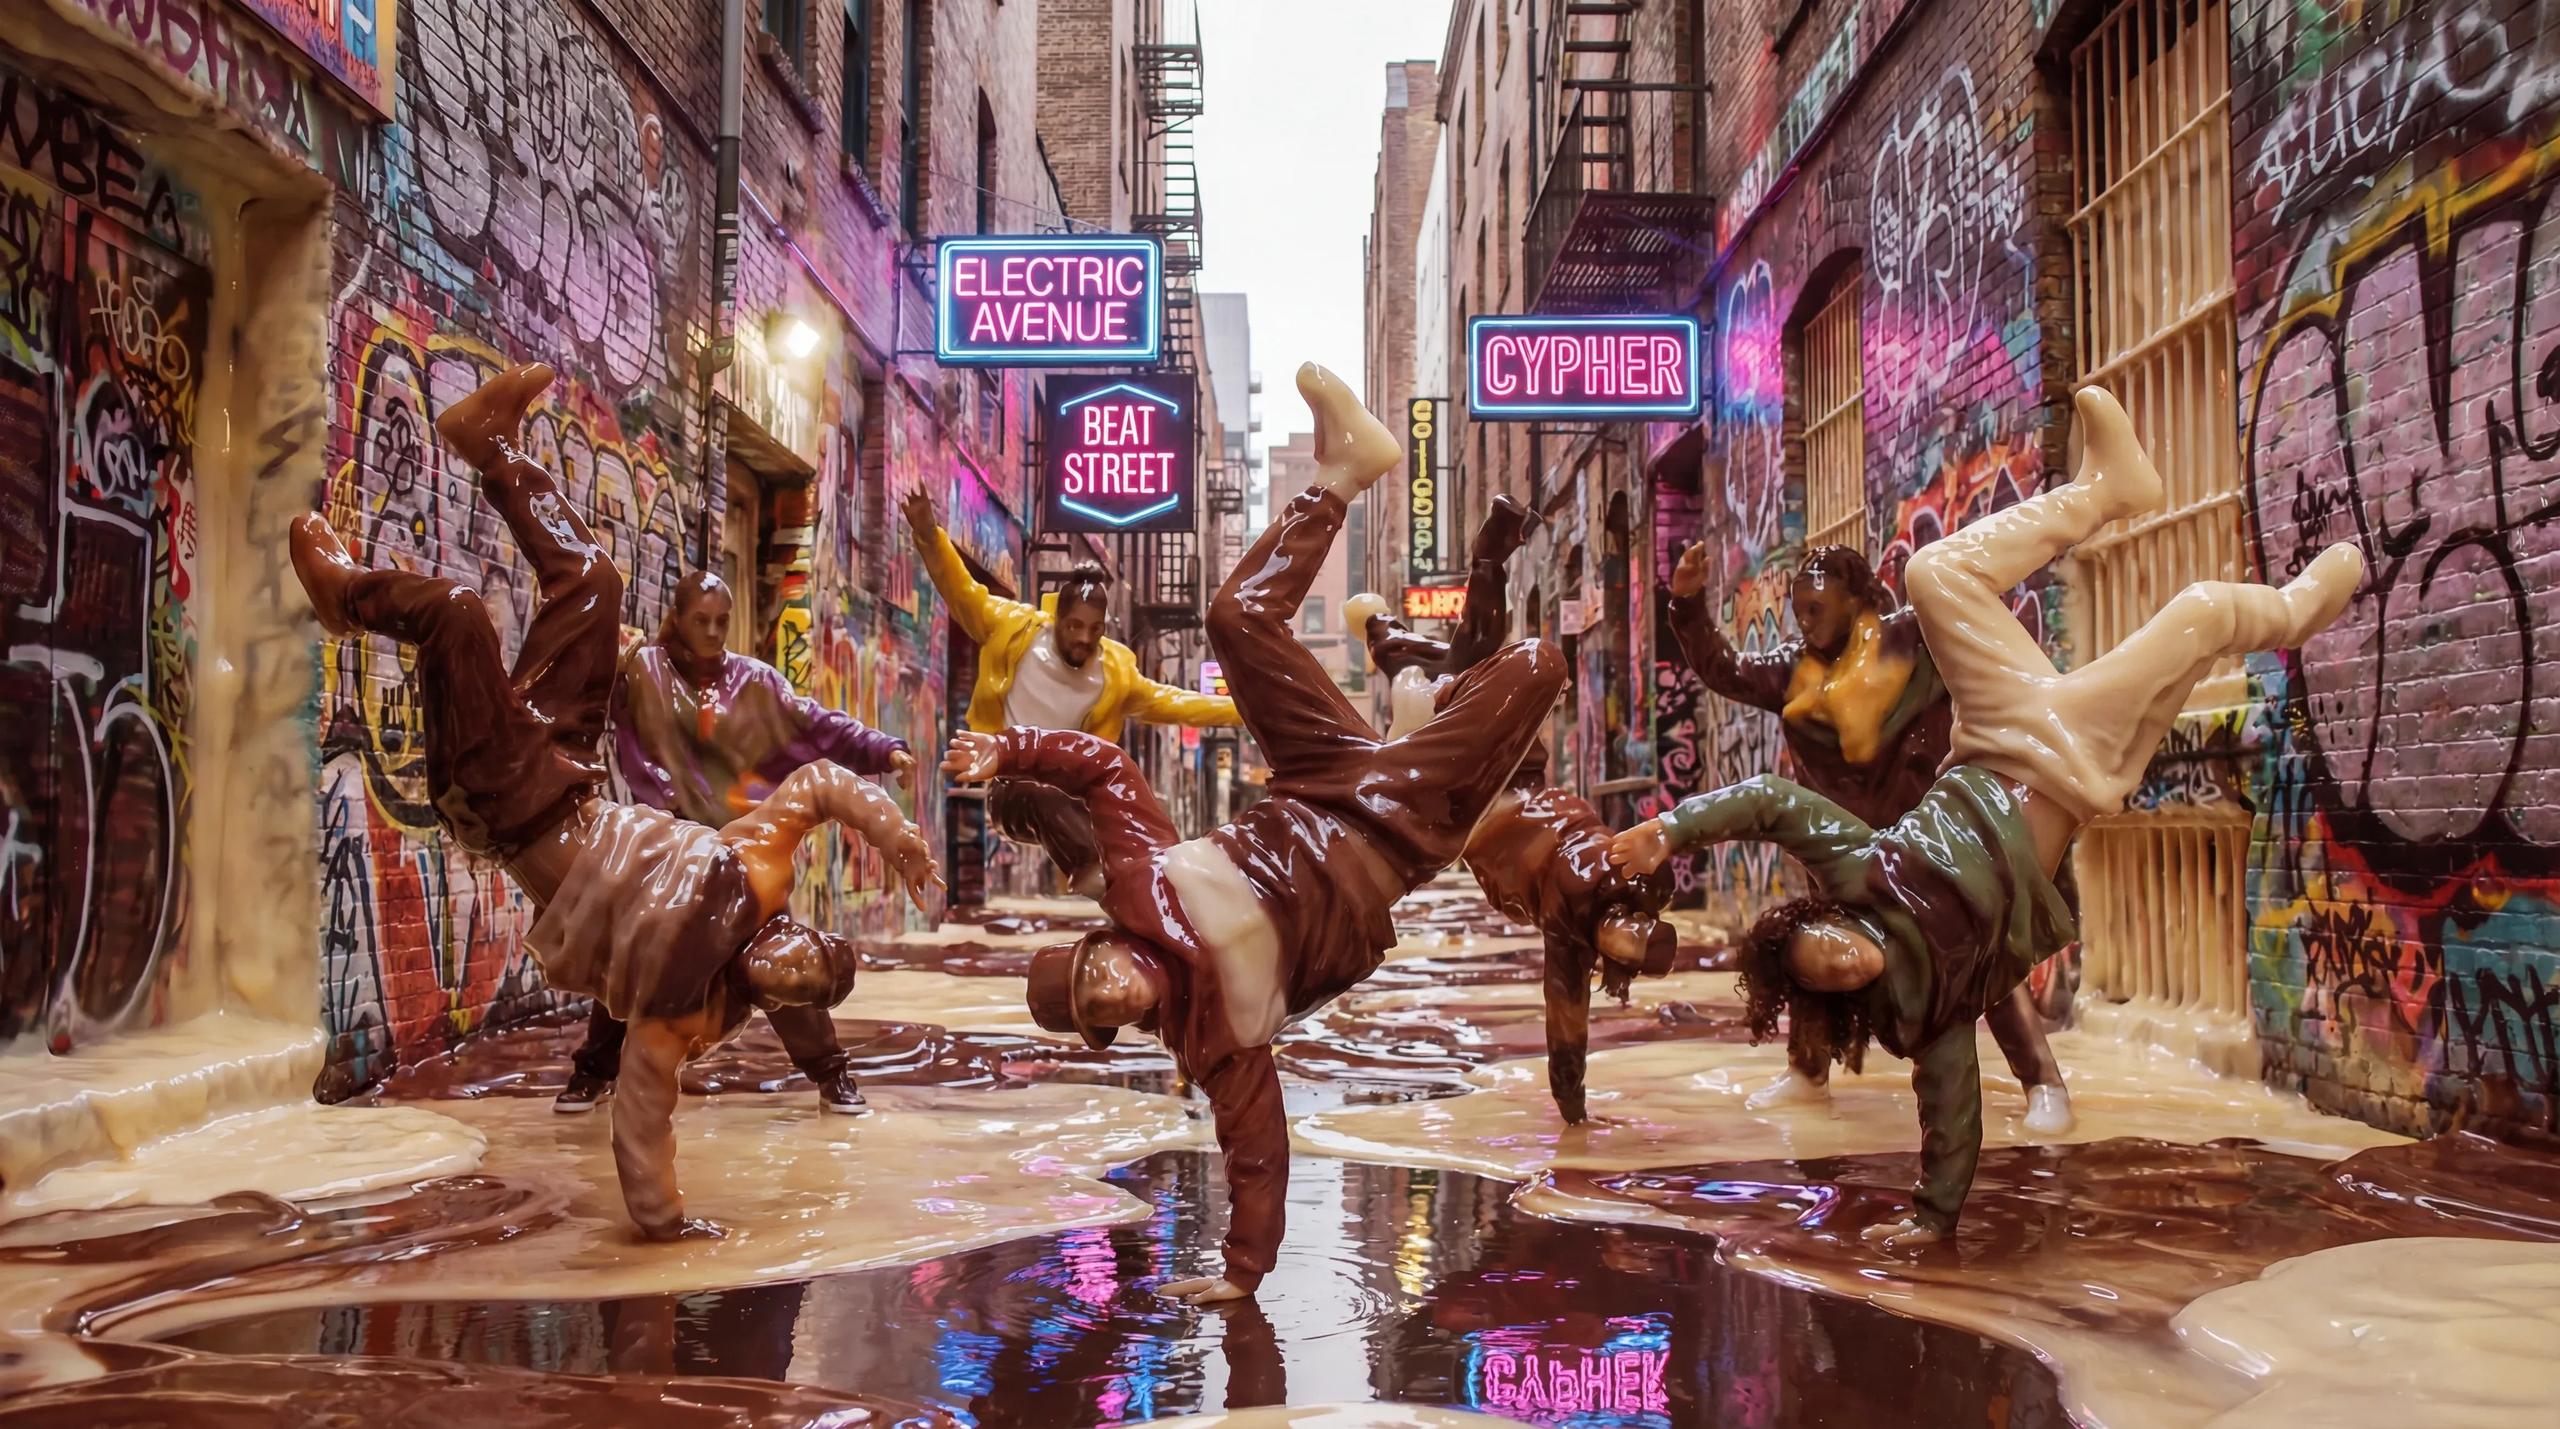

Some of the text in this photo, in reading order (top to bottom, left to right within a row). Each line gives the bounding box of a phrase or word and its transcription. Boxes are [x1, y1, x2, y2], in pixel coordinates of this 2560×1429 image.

[955, 256, 1144, 297] ELECTRIC
[969, 301, 1129, 343] AVENUE
[1485, 335, 1684, 396] CYPHER
[1083, 405, 1156, 446] BEAT
[1063, 452, 1175, 494] STREET
